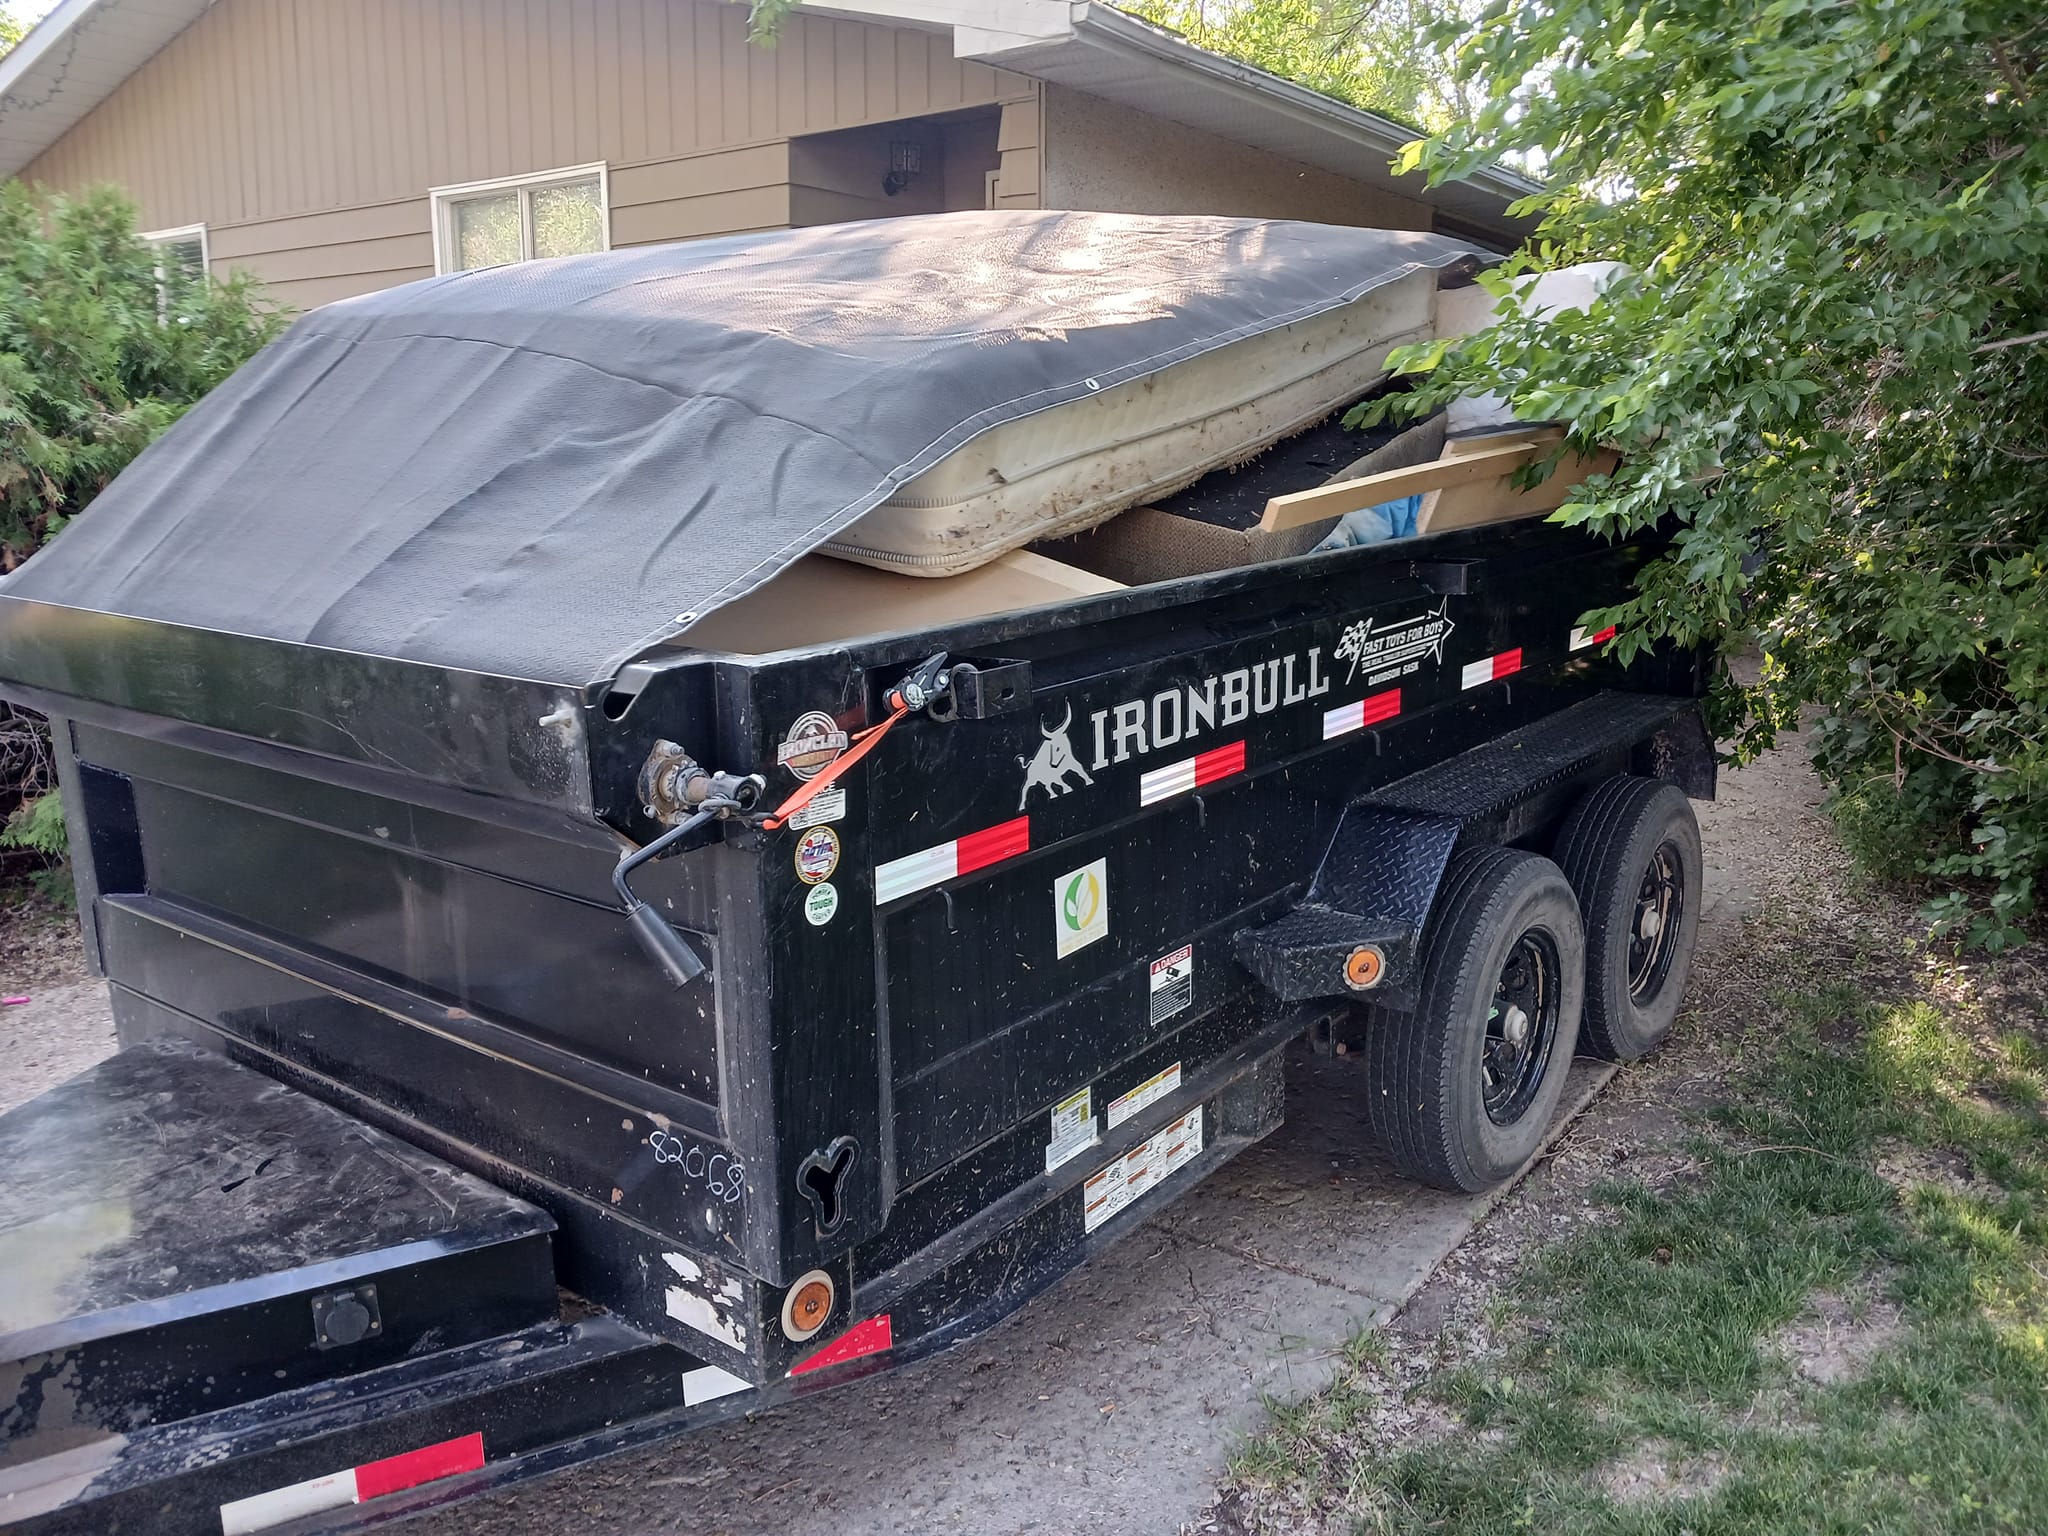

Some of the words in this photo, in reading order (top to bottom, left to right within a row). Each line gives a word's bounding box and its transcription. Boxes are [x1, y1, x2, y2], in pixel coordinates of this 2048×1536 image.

[1363, 637, 1385, 656] FAST
[1386, 631, 1407, 648] TOYS
[1407, 626, 1424, 642] FOR
[1424, 620, 1444, 637] BOYS
[1402, 661, 1419, 675] SASK
[1091, 647, 1329, 771] IRONBULL
[809, 897, 834, 911] TOUGH
[1161, 948, 1189, 969] DANGER
